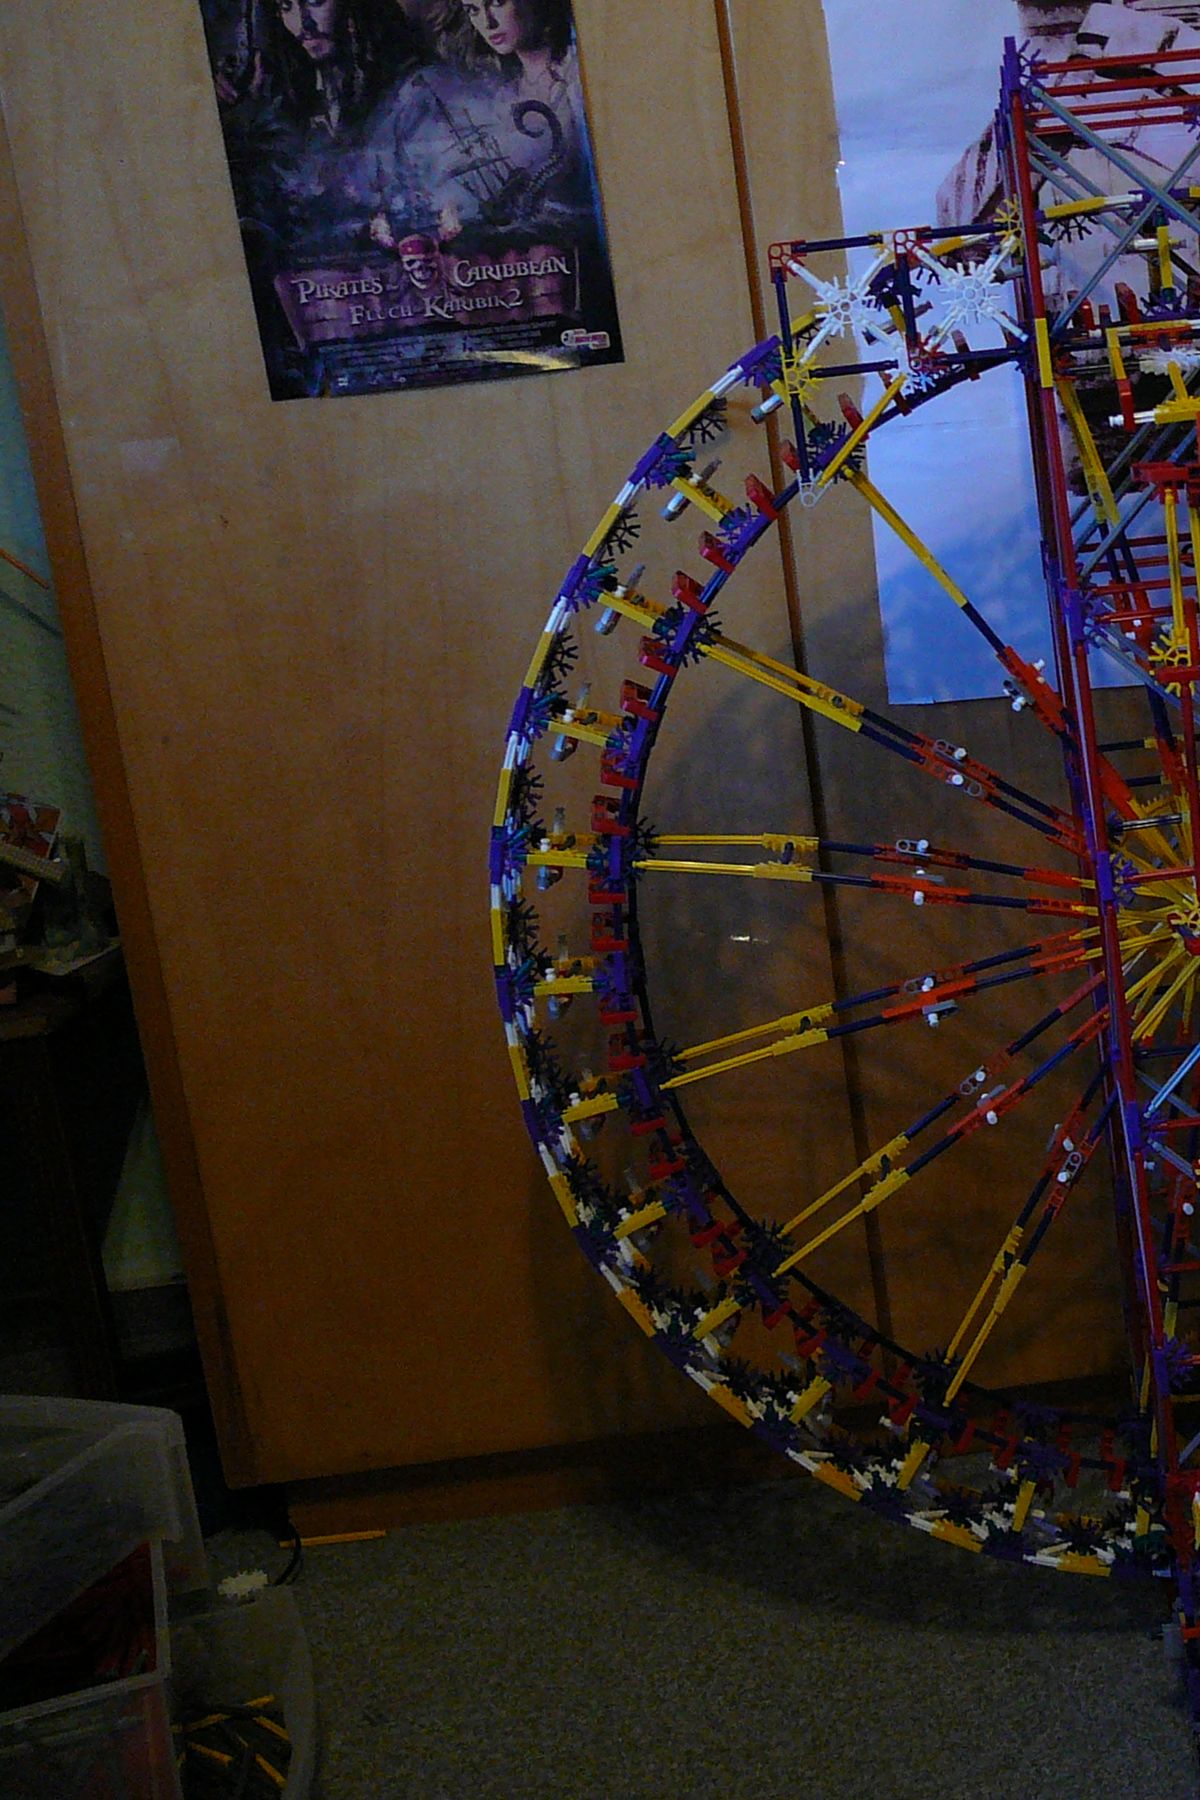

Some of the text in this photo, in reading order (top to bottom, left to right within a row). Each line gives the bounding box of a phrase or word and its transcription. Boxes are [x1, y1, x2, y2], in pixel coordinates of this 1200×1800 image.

[290, 256, 571, 304] PIRATES CARIBBEAN
[349, 304, 414, 326] FLUCH
[422, 293, 507, 319] KARIBIK
